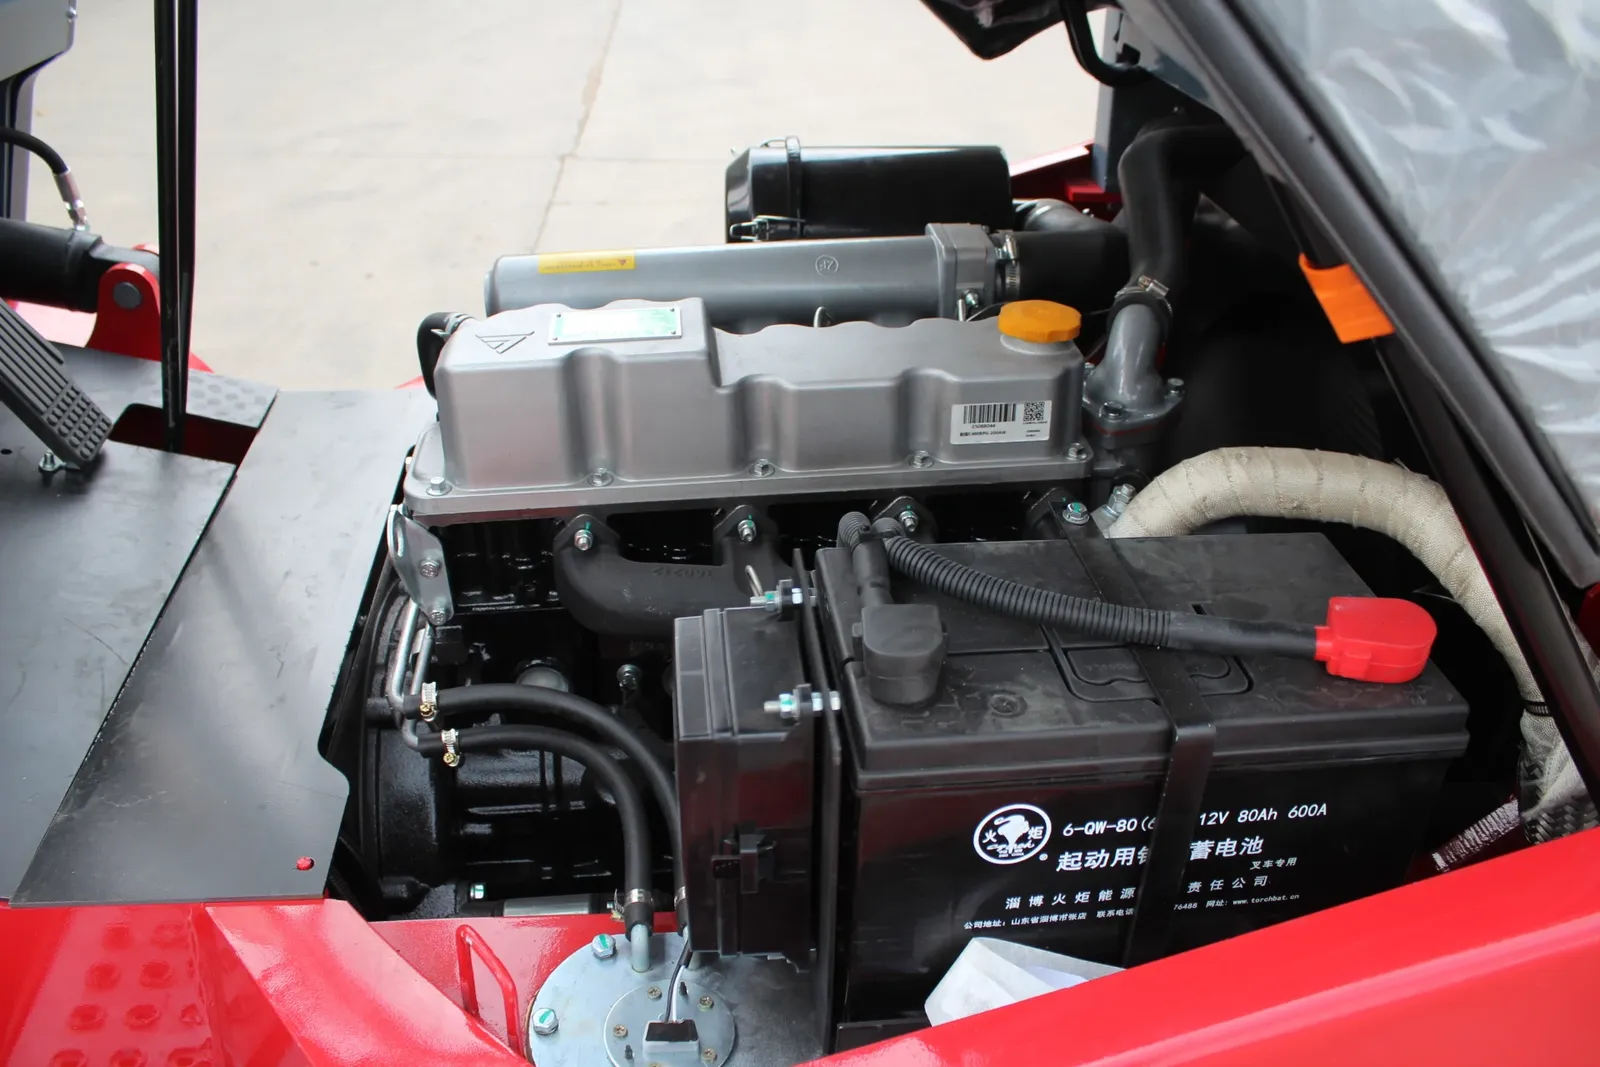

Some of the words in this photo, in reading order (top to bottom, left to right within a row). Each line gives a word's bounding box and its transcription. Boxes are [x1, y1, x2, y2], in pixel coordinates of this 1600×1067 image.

[1199, 811, 1230, 826] 12V
[1237, 808, 1278, 823] 80Ah
[1287, 803, 1328, 819] 600A
[1189, 836, 1264, 861] 蓄电池
[1250, 857, 1298, 870] 叉车专用
